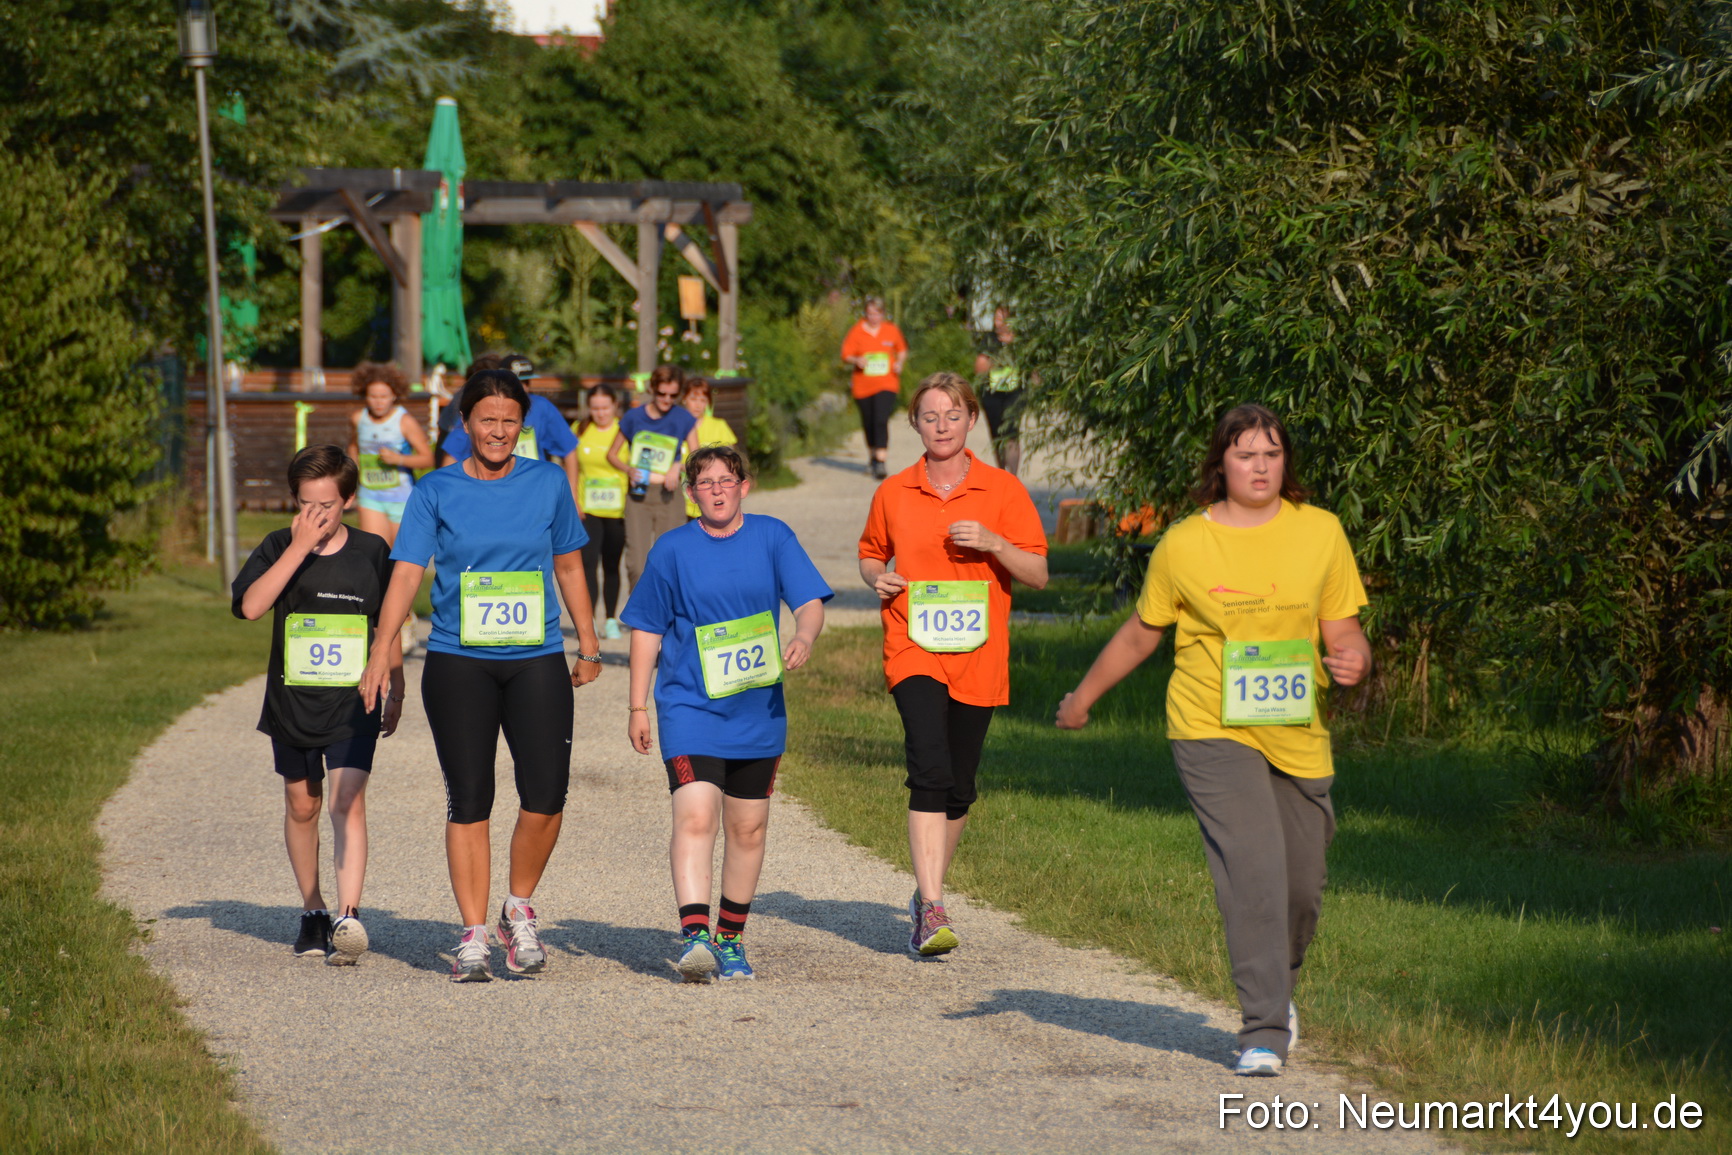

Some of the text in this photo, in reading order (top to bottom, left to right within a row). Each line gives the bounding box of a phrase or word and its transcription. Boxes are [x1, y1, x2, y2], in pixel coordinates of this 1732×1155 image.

[478, 601, 528, 625] 730
[1222, 598, 1265, 608] Seniorenstift
[1237, 606, 1256, 615] Tiroler
[1257, 604, 1270, 613] Hof
[1275, 602, 1309, 611] Neumarkt
[917, 609, 981, 632] 1032
[309, 643, 342, 666] 95
[718, 645, 766, 675] 762
[1234, 673, 1307, 701] 1336
